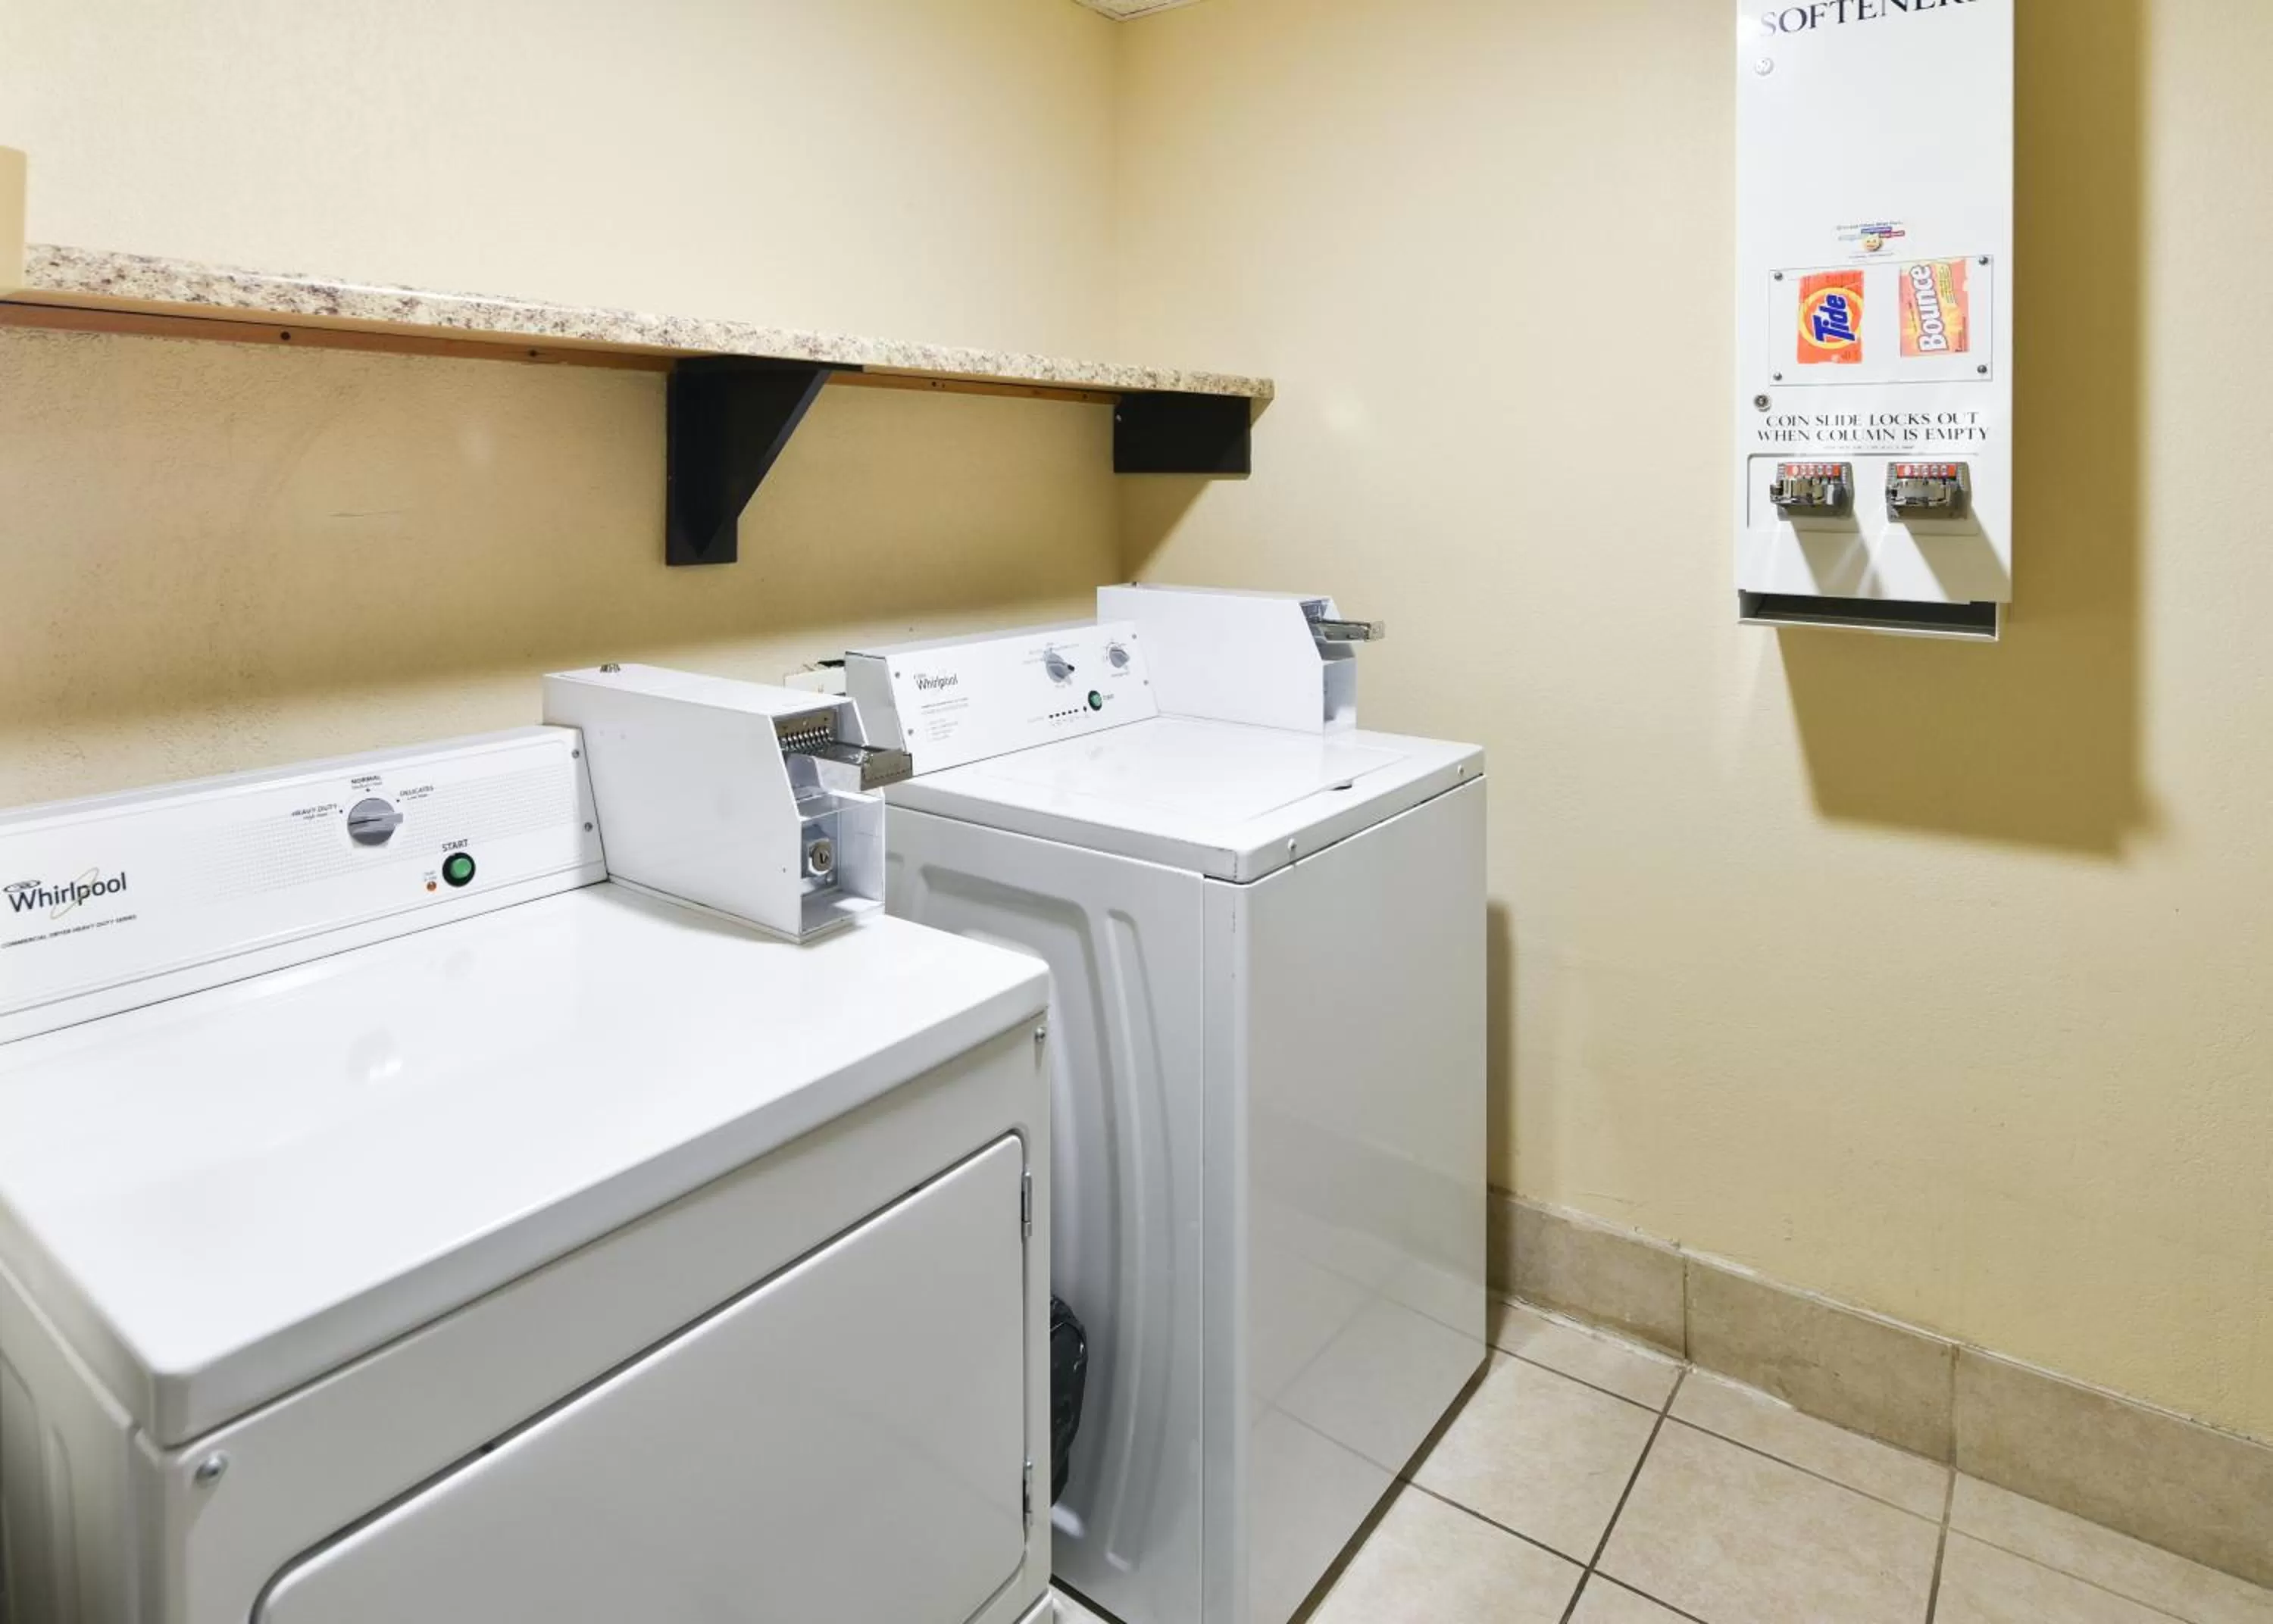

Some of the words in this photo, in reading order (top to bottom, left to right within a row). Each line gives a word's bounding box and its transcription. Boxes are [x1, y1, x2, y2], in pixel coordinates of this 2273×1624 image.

[1760, 0, 1977, 36] SOFTEN
[1812, 294, 1856, 342] Tide
[1909, 264, 1949, 352] Bounce
[1766, 414, 1809, 427] COIN
[1815, 414, 1862, 426] SLIDE
[1869, 413, 1931, 426] LOCKS
[1937, 411, 1979, 426] OUT
[1757, 429, 1810, 442] WHEN
[1816, 429, 1895, 442] COLUMN
[1903, 428, 1918, 441] IS
[1924, 426, 1990, 441] EMPTY
[915, 673, 958, 691] Whirlpool
[442, 839, 468, 852] START
[8, 871, 127, 913] Whirlpool
